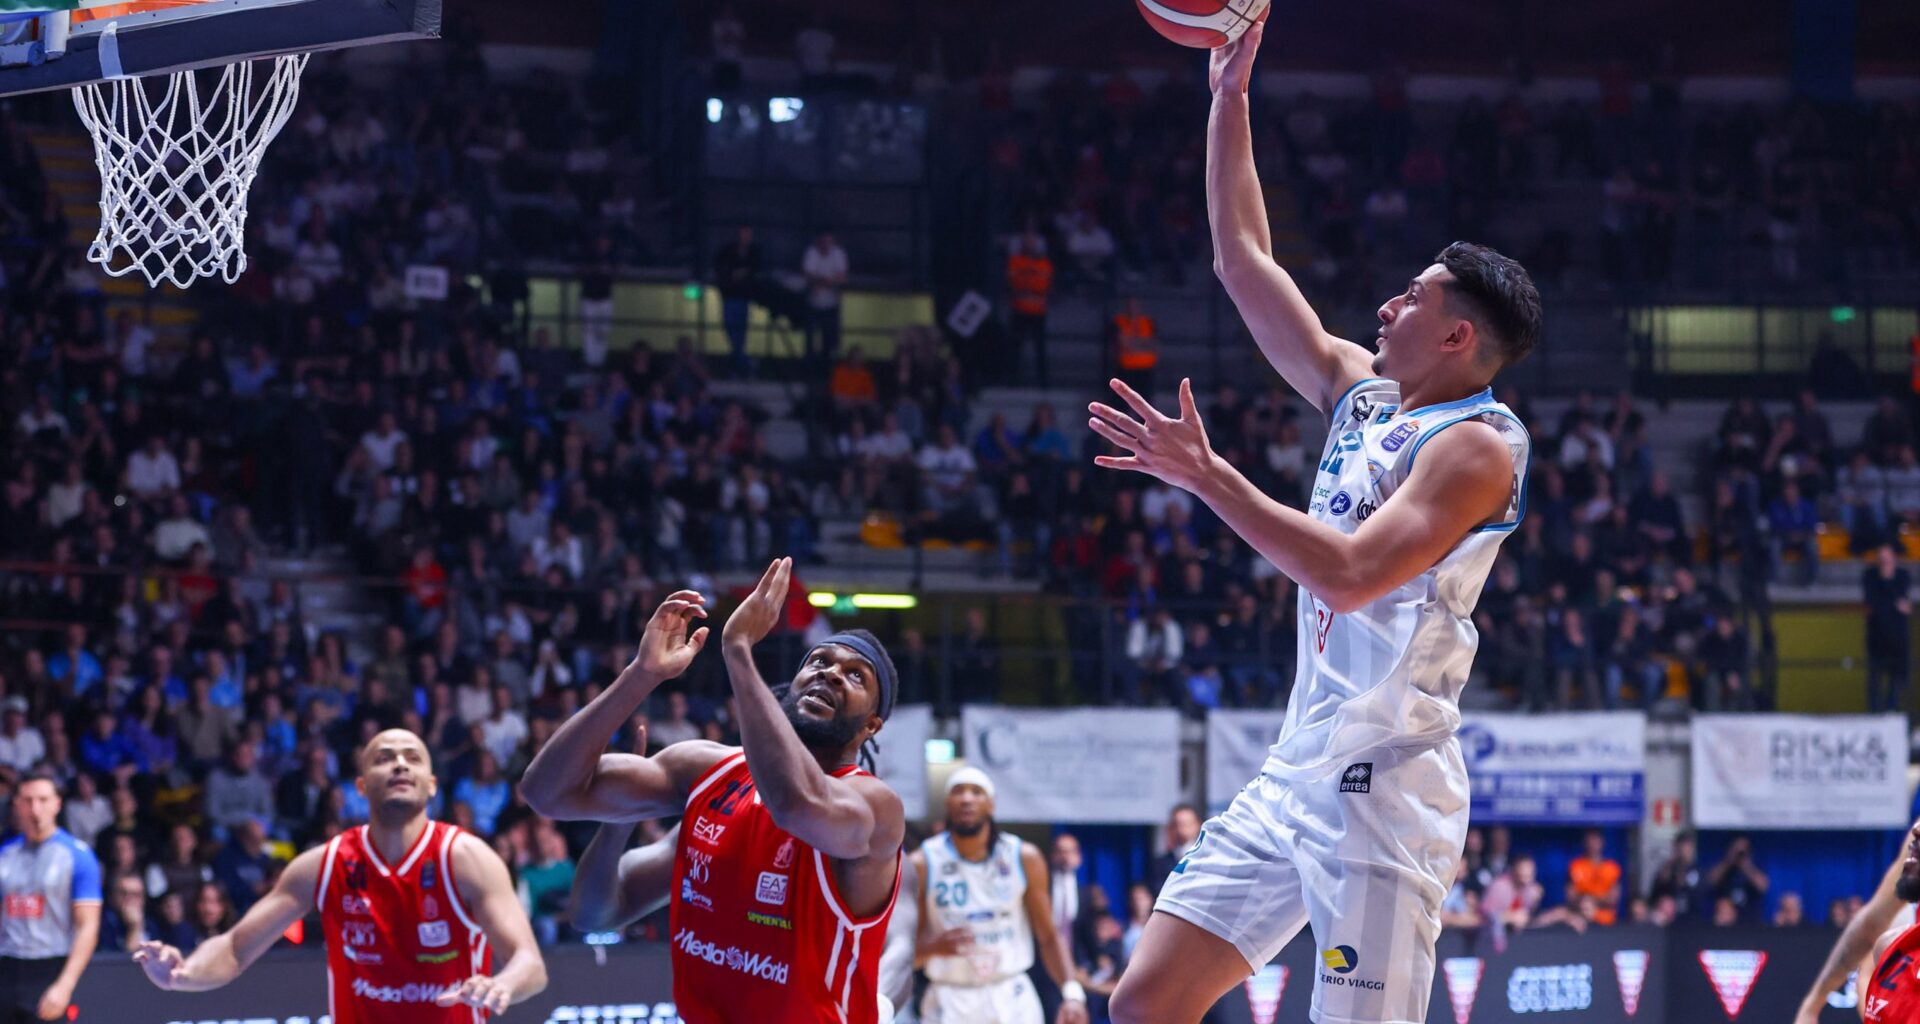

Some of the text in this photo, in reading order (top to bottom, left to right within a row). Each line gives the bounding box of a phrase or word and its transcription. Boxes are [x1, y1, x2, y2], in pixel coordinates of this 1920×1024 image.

[1341, 782, 1369, 792] errea
[693, 815, 726, 841] EA7
[935, 880, 968, 908] 20
[674, 927, 789, 985] Media World
[1319, 974, 1385, 991] ERIO VIAGGI
